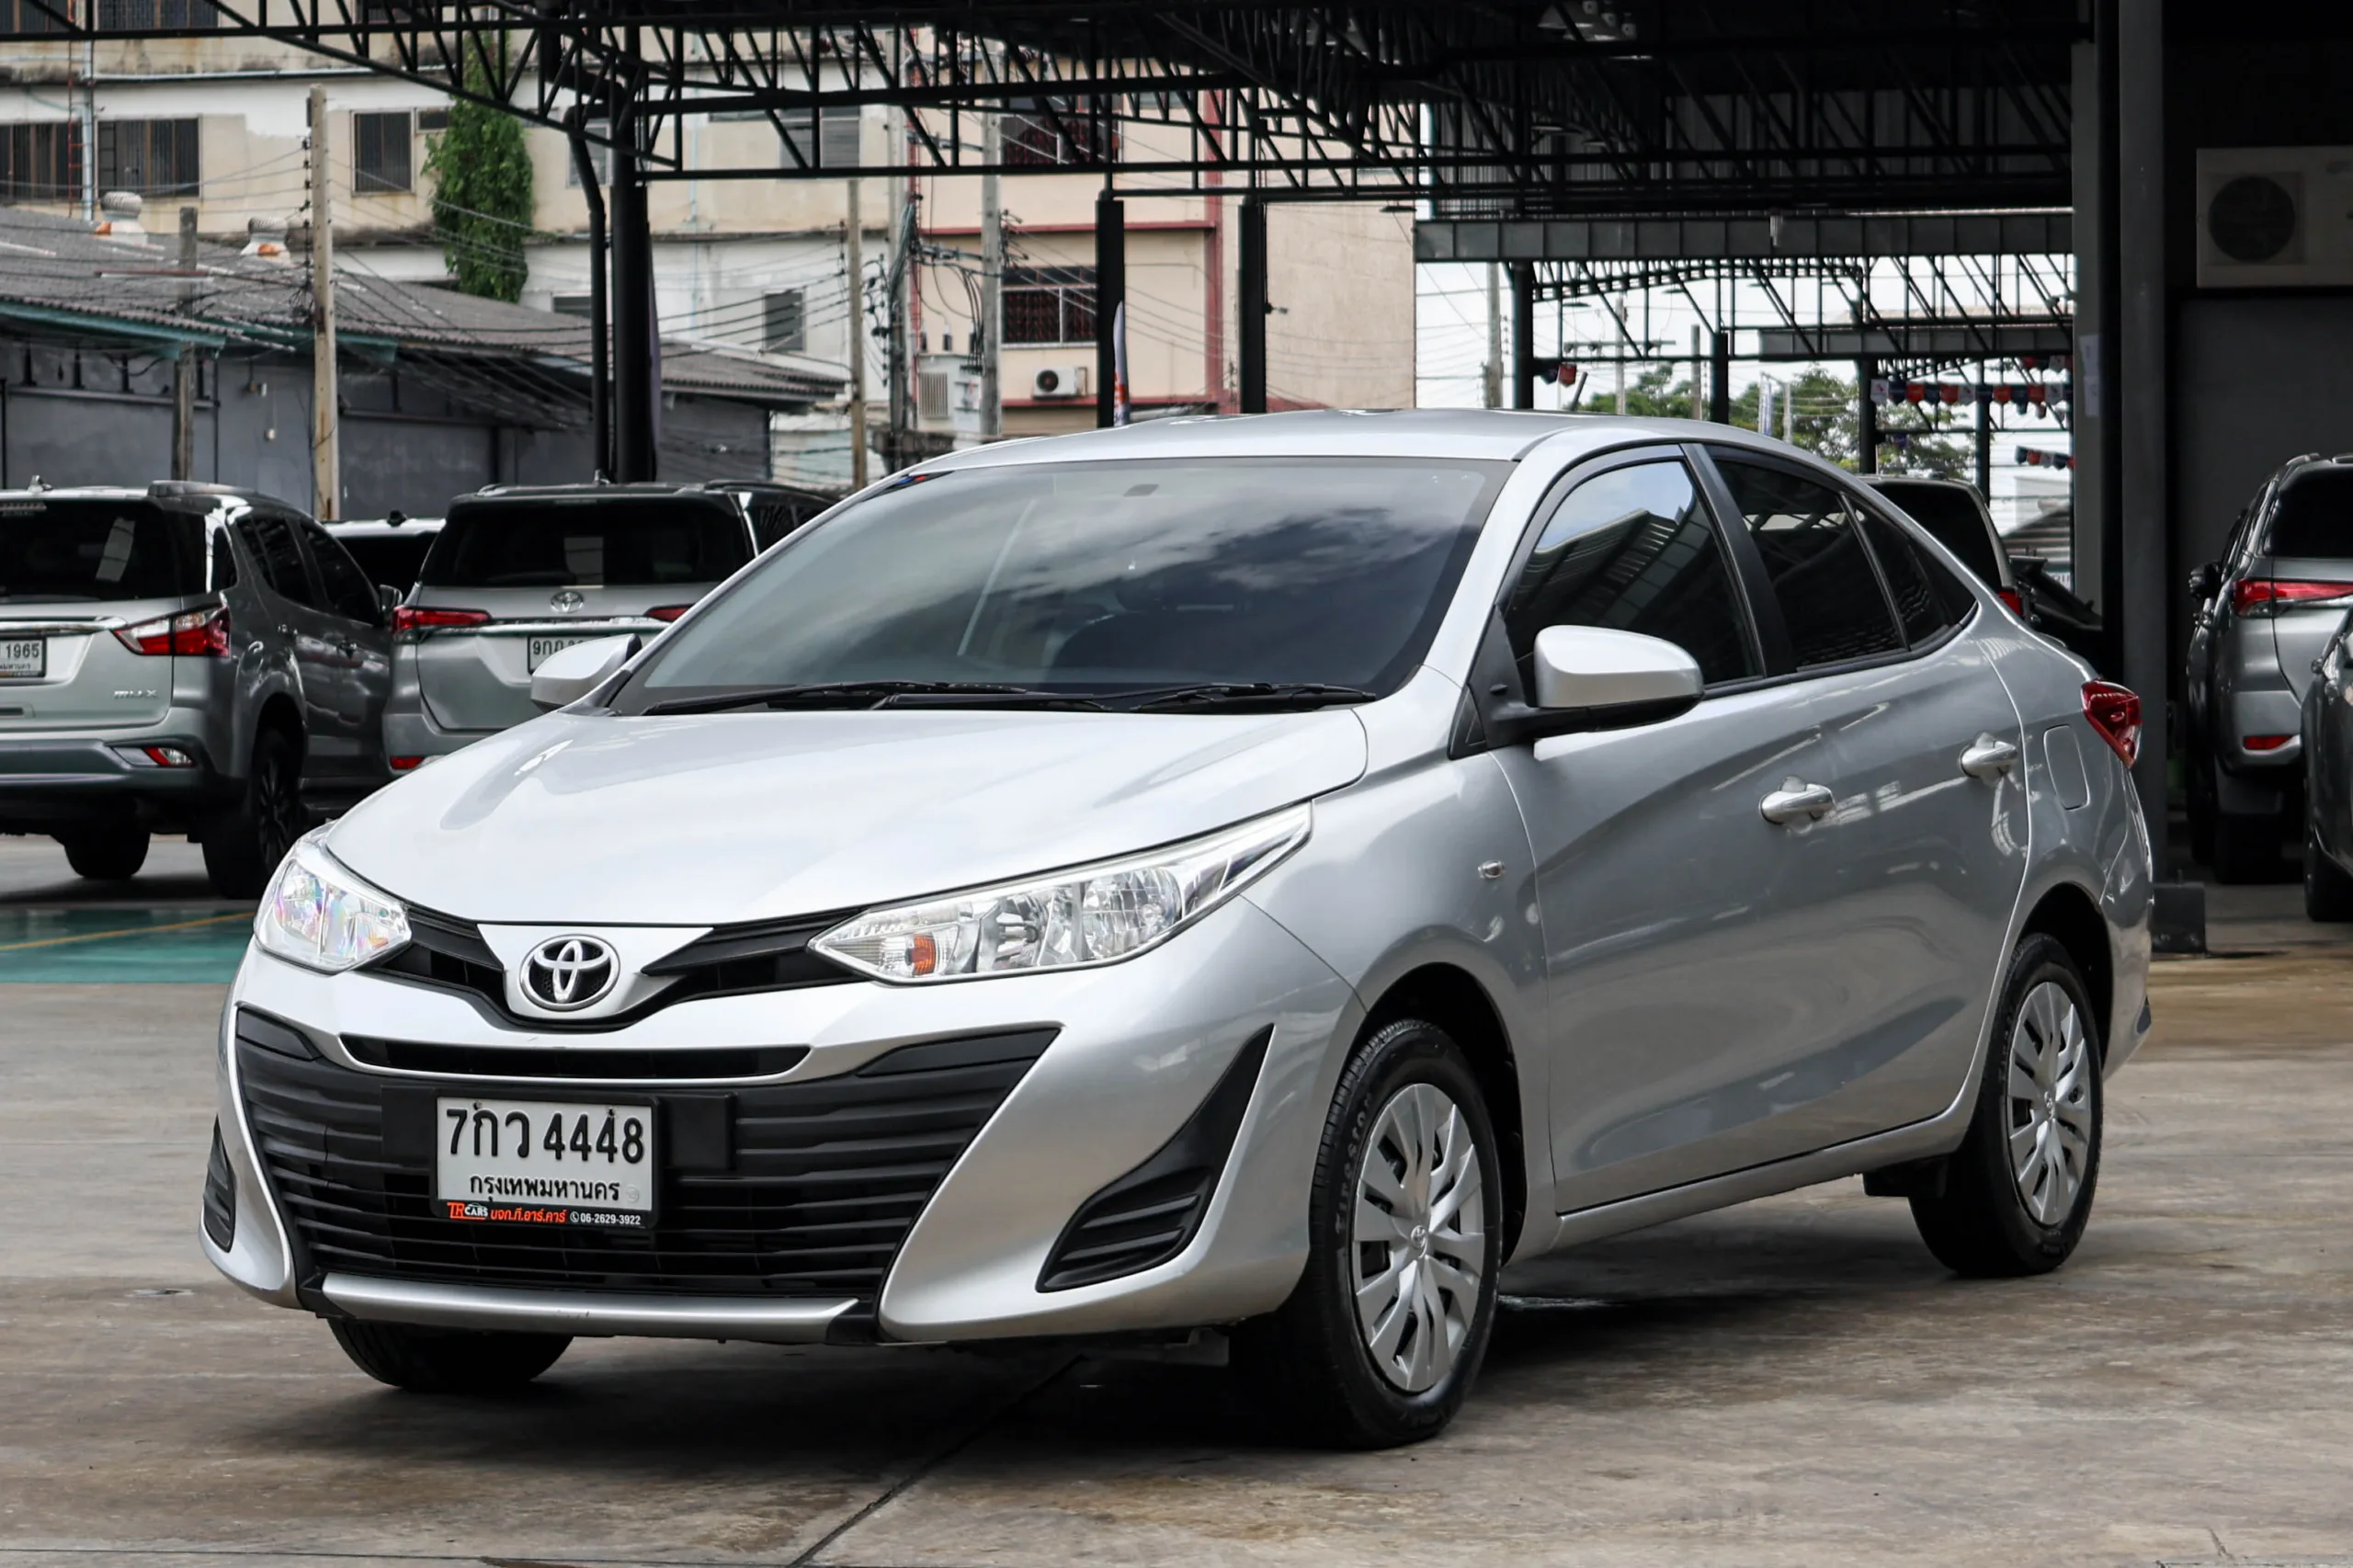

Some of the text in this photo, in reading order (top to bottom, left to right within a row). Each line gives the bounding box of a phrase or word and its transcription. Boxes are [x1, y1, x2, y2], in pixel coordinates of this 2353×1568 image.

[6, 643, 40, 658] 1965
[446, 1108, 644, 1164] 7กว 4448
[470, 1175, 620, 1202] กรุงเทพมหานคร
[580, 1212, 642, 1225] 06-2629-3922
